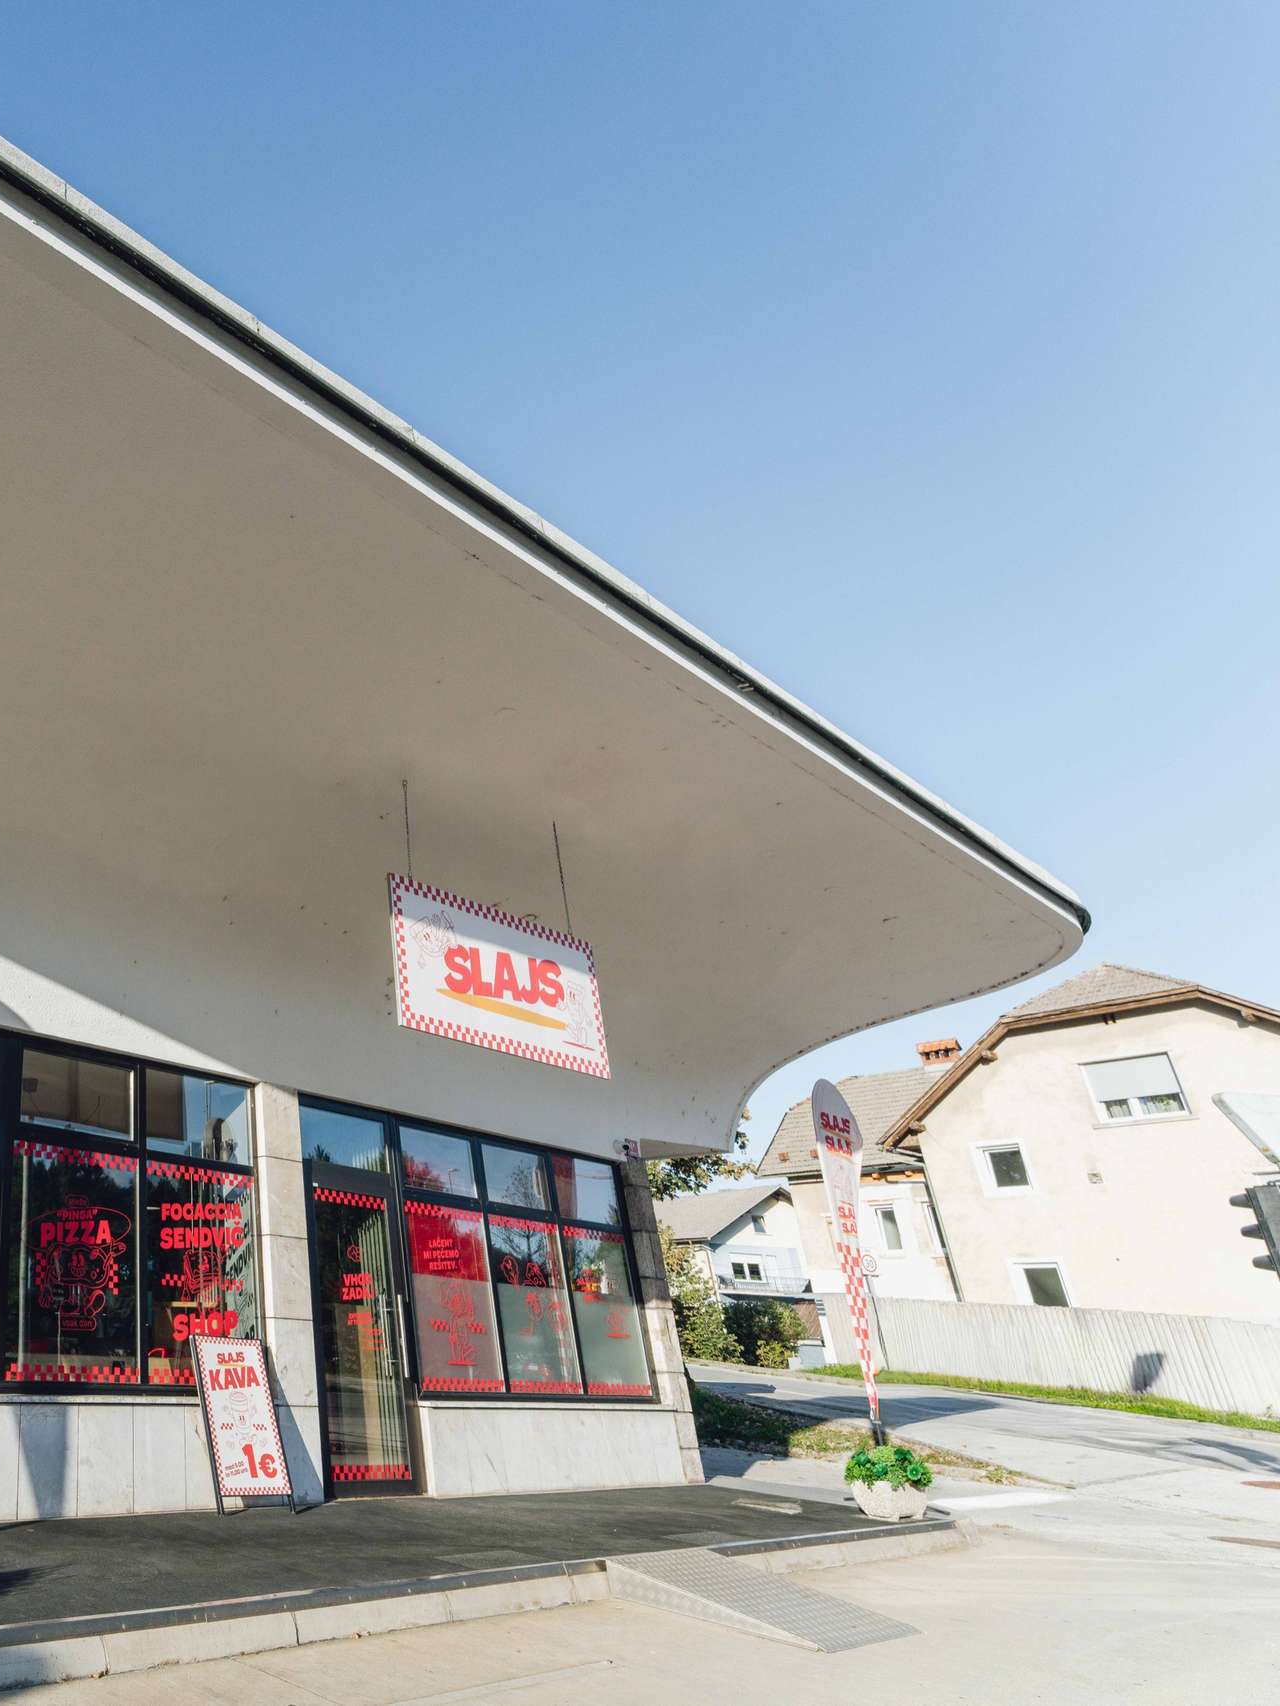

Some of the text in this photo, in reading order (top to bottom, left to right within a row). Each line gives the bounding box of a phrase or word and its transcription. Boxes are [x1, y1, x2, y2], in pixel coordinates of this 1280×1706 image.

[444, 944, 565, 1008] SLAJS
[161, 1202, 243, 1221] FOCACCIA
[40, 1219, 113, 1249] PIZZA
[159, 1220, 244, 1249] SENDVIČ
[173, 1310, 238, 1341] SHOP
[216, 1352, 246, 1365] SLAJS
[208, 1366, 261, 1392] KAVA
